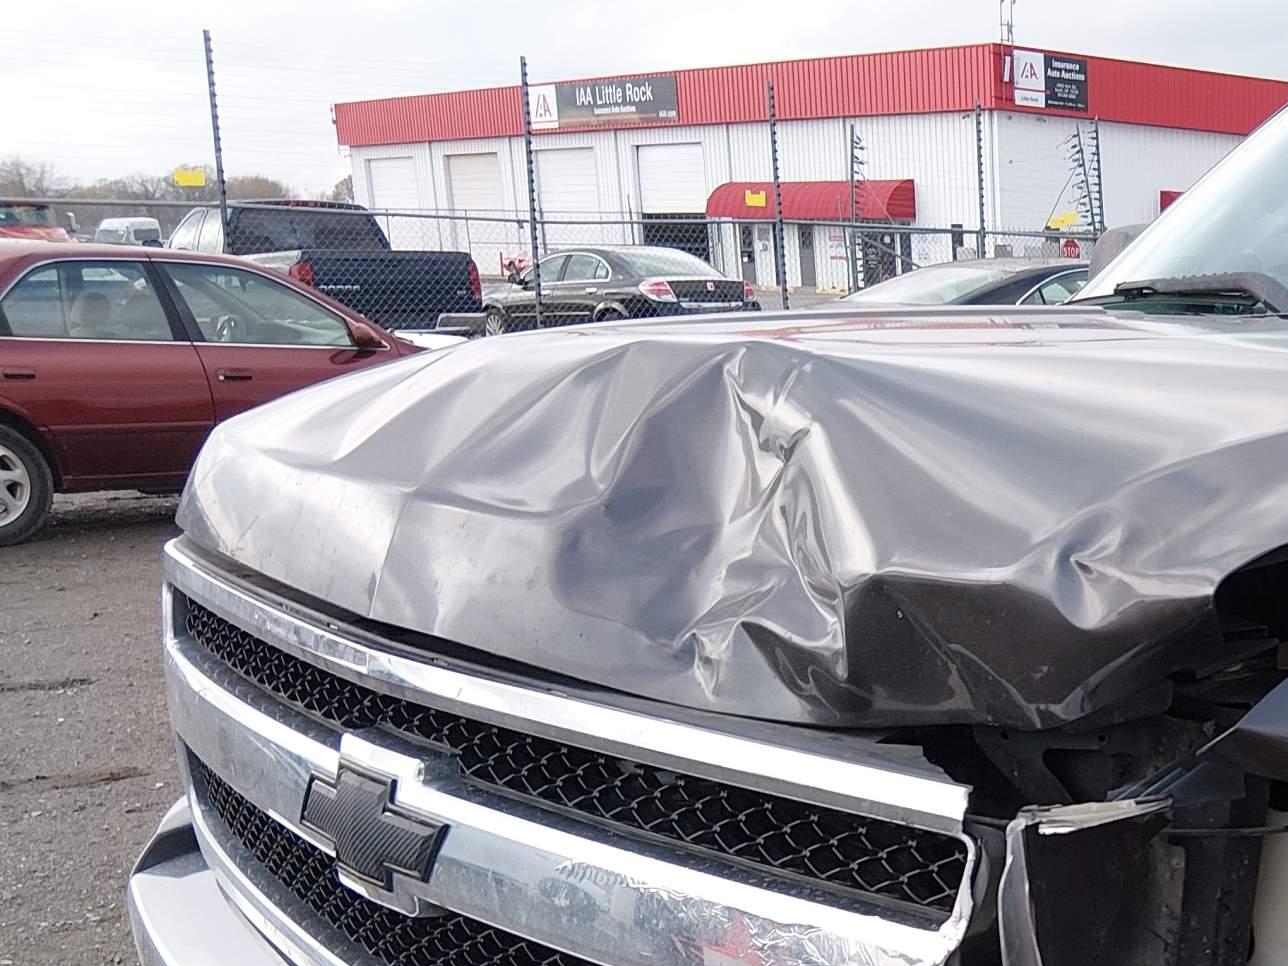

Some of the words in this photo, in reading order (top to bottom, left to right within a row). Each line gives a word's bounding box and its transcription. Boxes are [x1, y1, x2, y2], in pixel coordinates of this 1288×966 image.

[1052, 58, 1079, 71] Insurance
[1047, 68, 1060, 79] Auto
[1060, 70, 1085, 82] Auctions
[575, 87, 593, 107] IAA
[595, 84, 623, 105] Little
[626, 81, 653, 103] Rock
[1063, 246, 1081, 258] STOP
